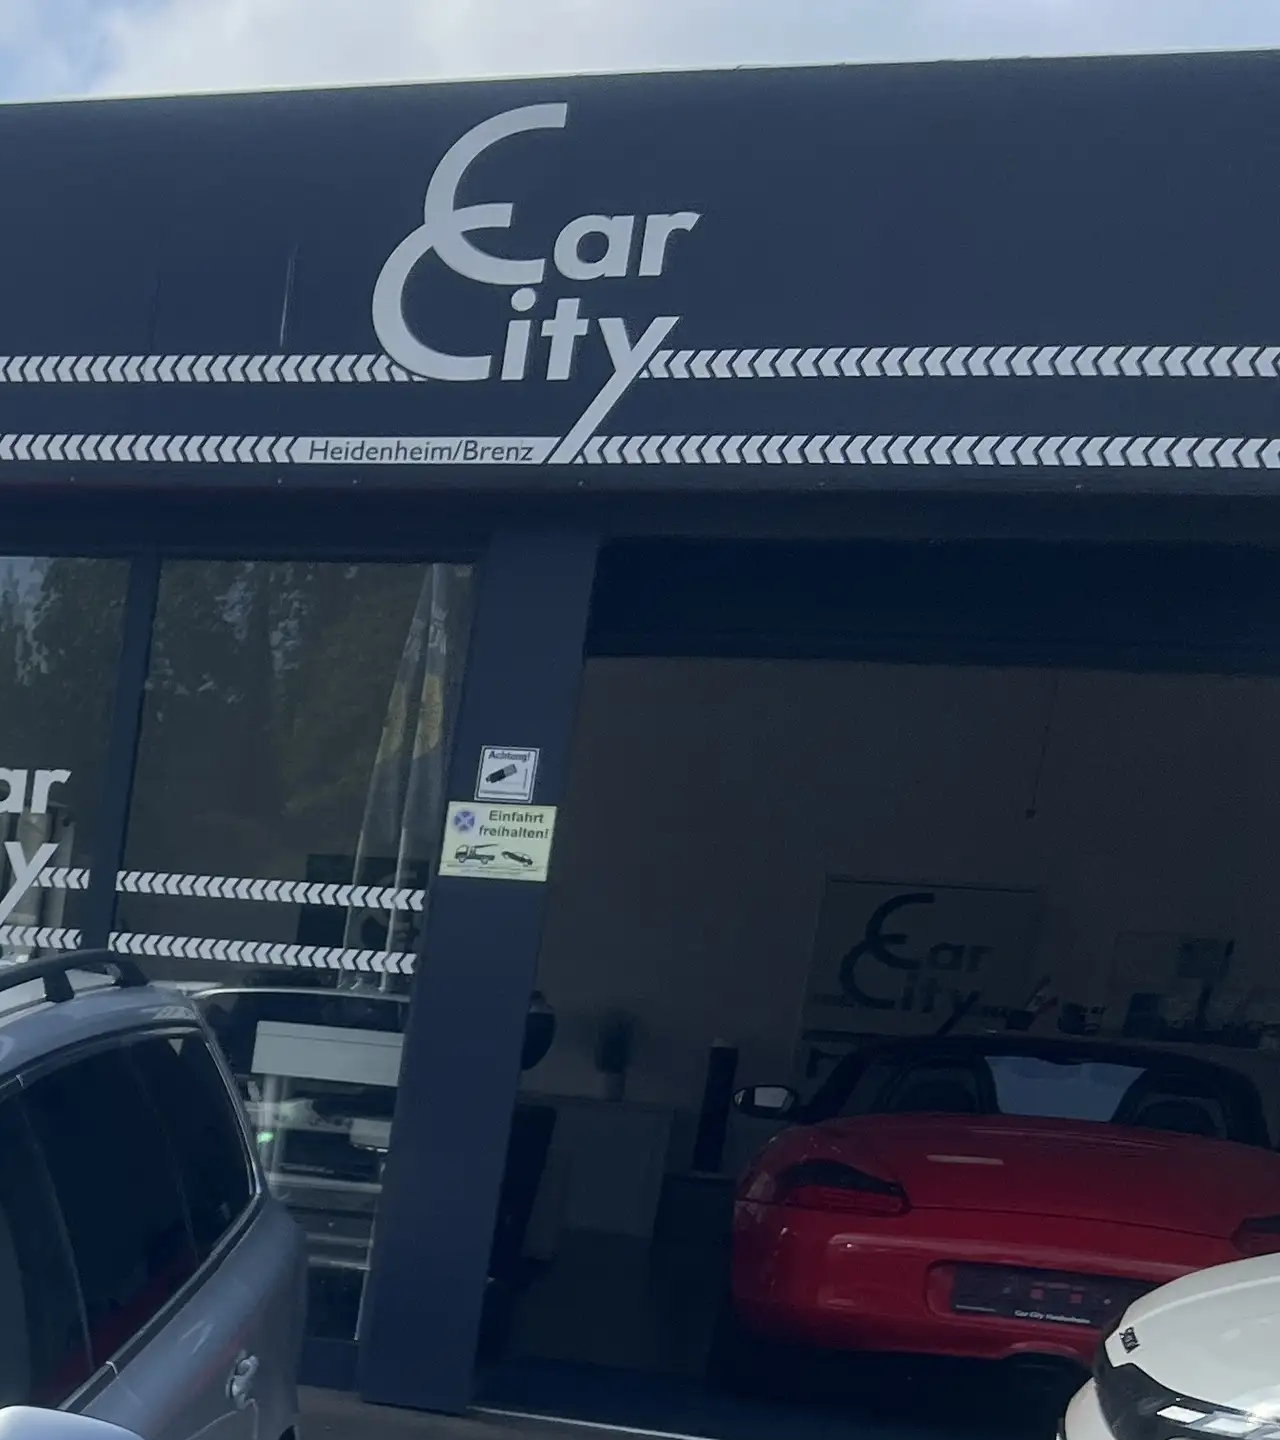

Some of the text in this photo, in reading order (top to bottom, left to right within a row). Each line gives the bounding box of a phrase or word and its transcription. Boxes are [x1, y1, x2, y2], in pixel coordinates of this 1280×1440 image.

[424, 102, 702, 285] Car
[372, 203, 680, 464] City
[308, 439, 534, 462] Heidenheim/Brenz
[488, 809, 545, 825] Einfahrt
[478, 825, 550, 840] freihalten!
